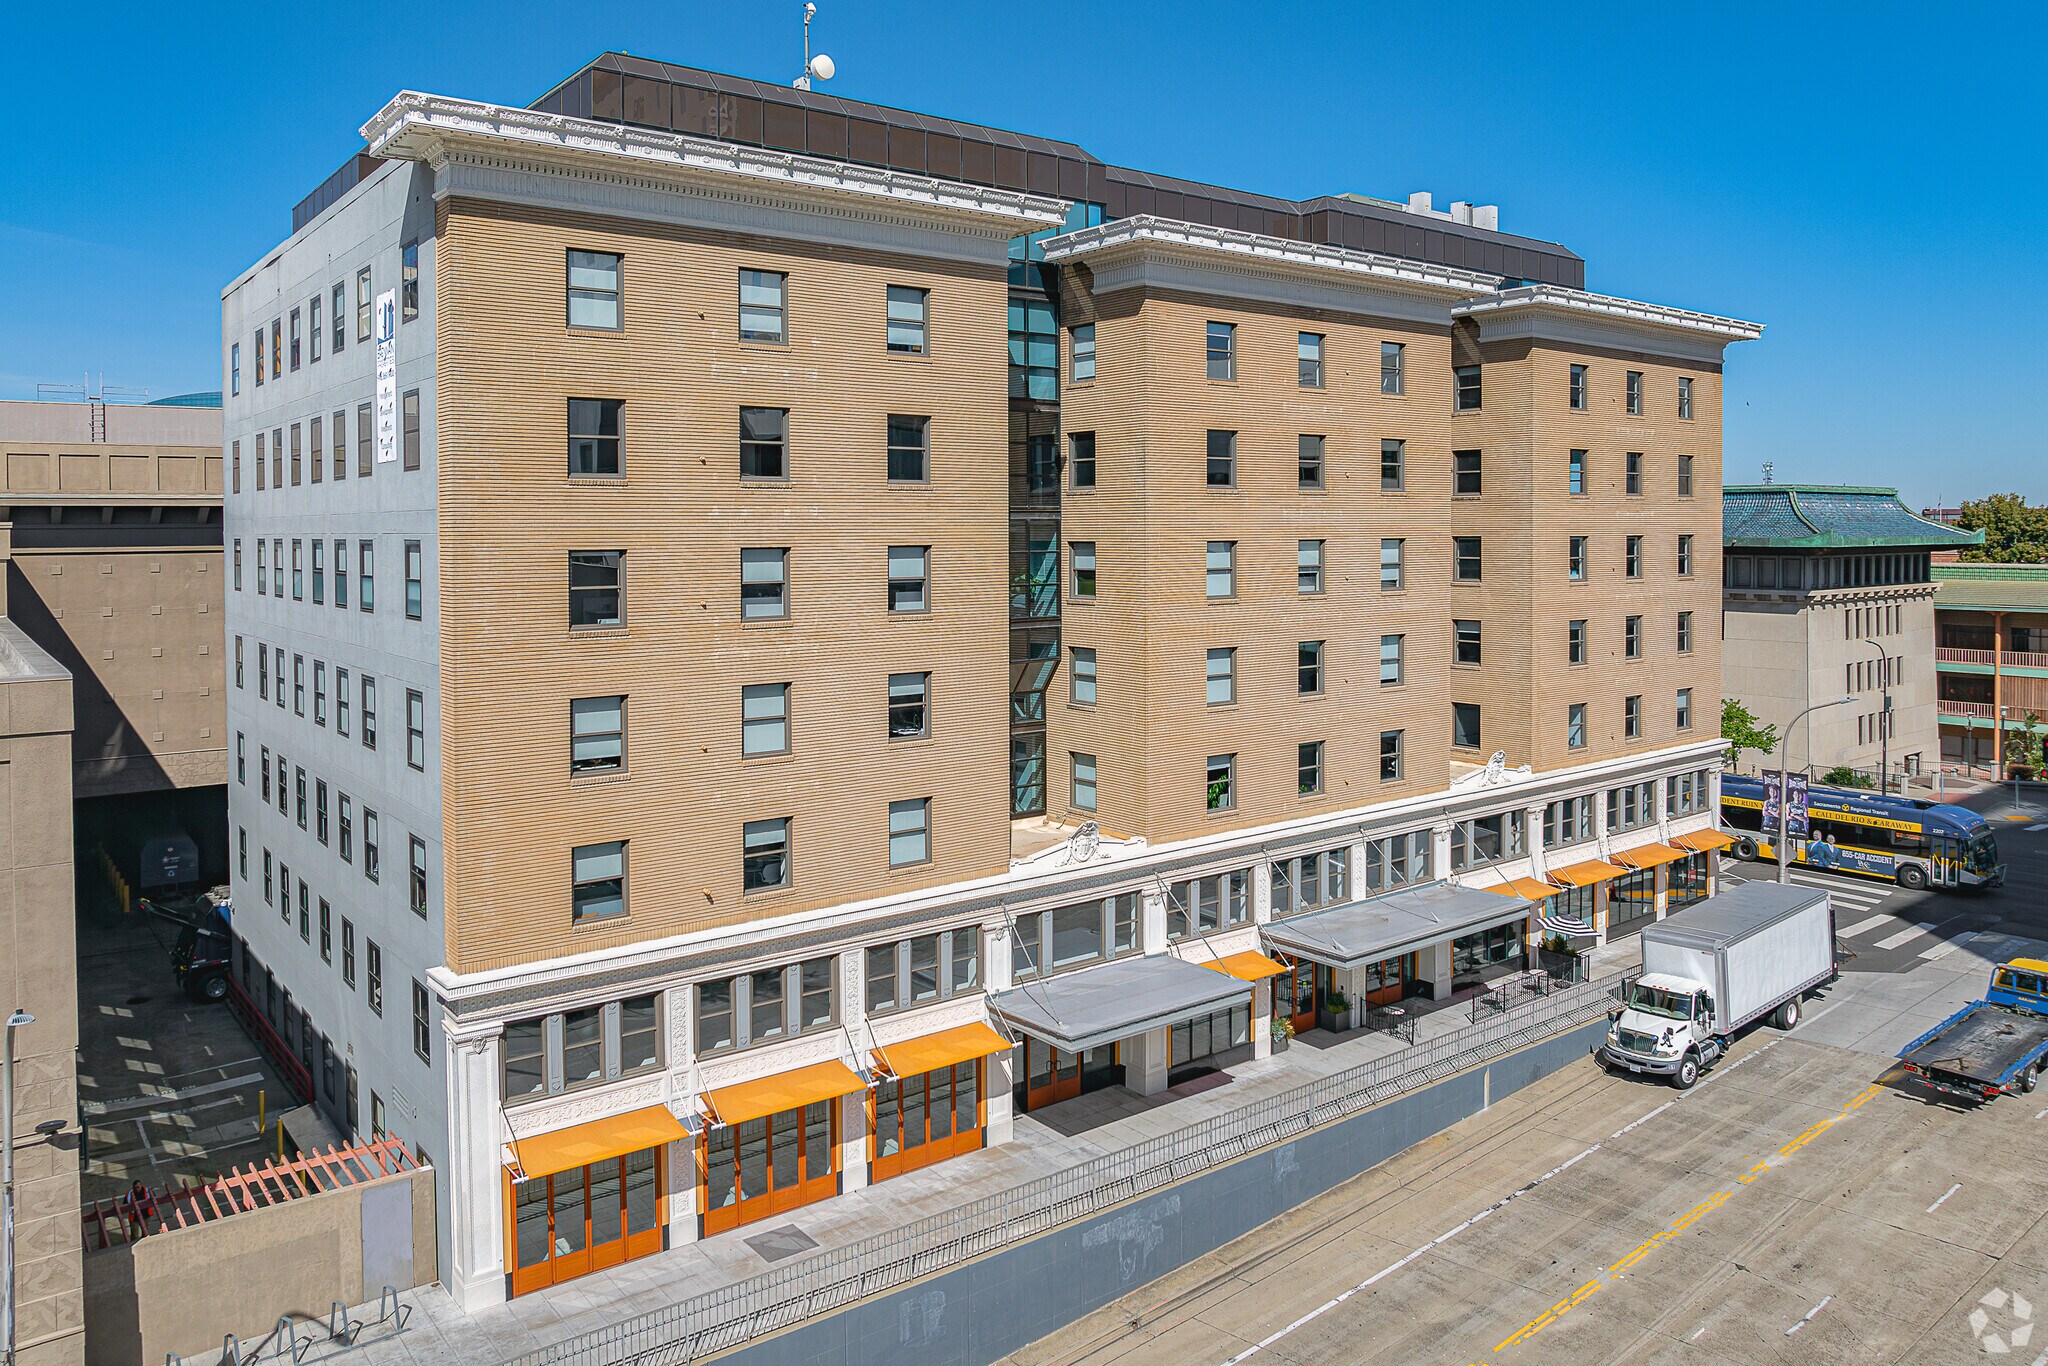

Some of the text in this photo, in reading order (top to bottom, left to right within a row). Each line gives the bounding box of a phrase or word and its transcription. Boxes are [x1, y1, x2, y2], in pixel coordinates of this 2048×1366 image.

[1741, 800, 1759, 808] RUIN
[1813, 801, 1889, 817] Sacramento Regional Transit
[1816, 811, 1832, 819] CALL
[1835, 813, 1848, 821] DEL
[1851, 815, 1865, 823] RIO
[1841, 849, 1893, 865] 855-CAR ACCIDENT
